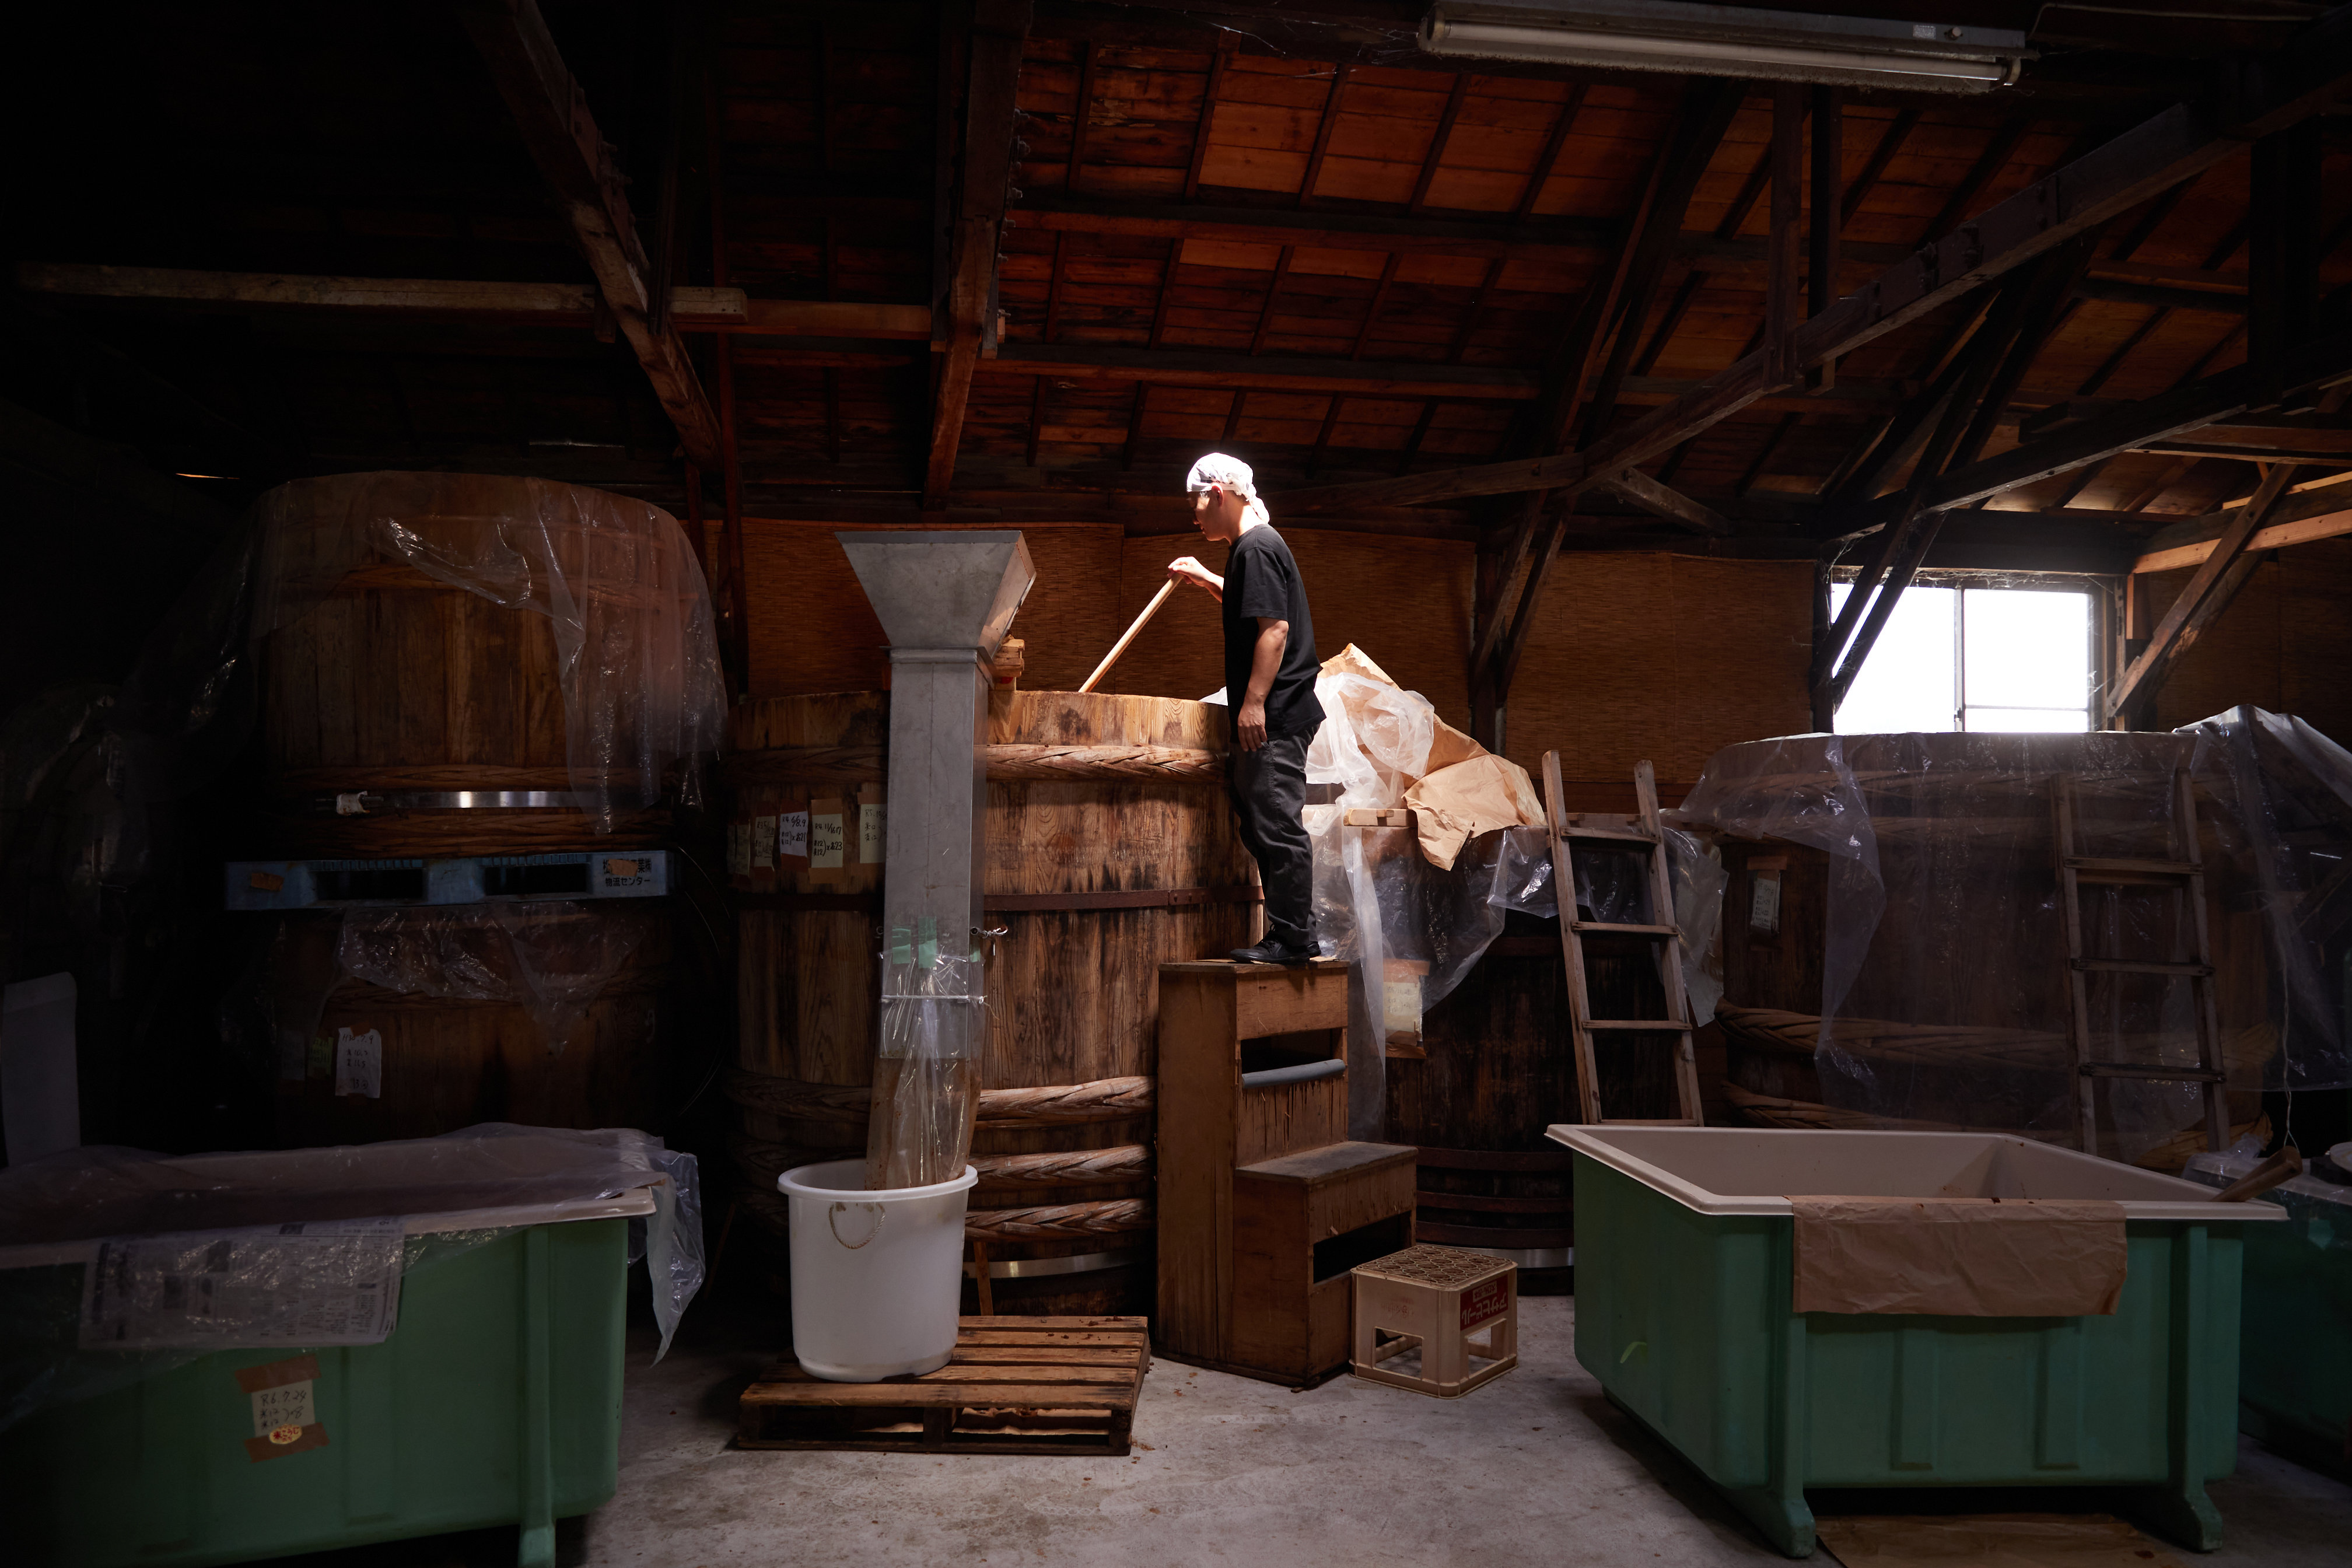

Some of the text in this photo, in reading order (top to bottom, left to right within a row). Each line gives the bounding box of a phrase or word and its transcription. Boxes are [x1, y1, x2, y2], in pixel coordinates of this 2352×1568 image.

[605, 877, 650, 887] 物流センター
[1461, 1292, 1507, 1325] アサヒビール
